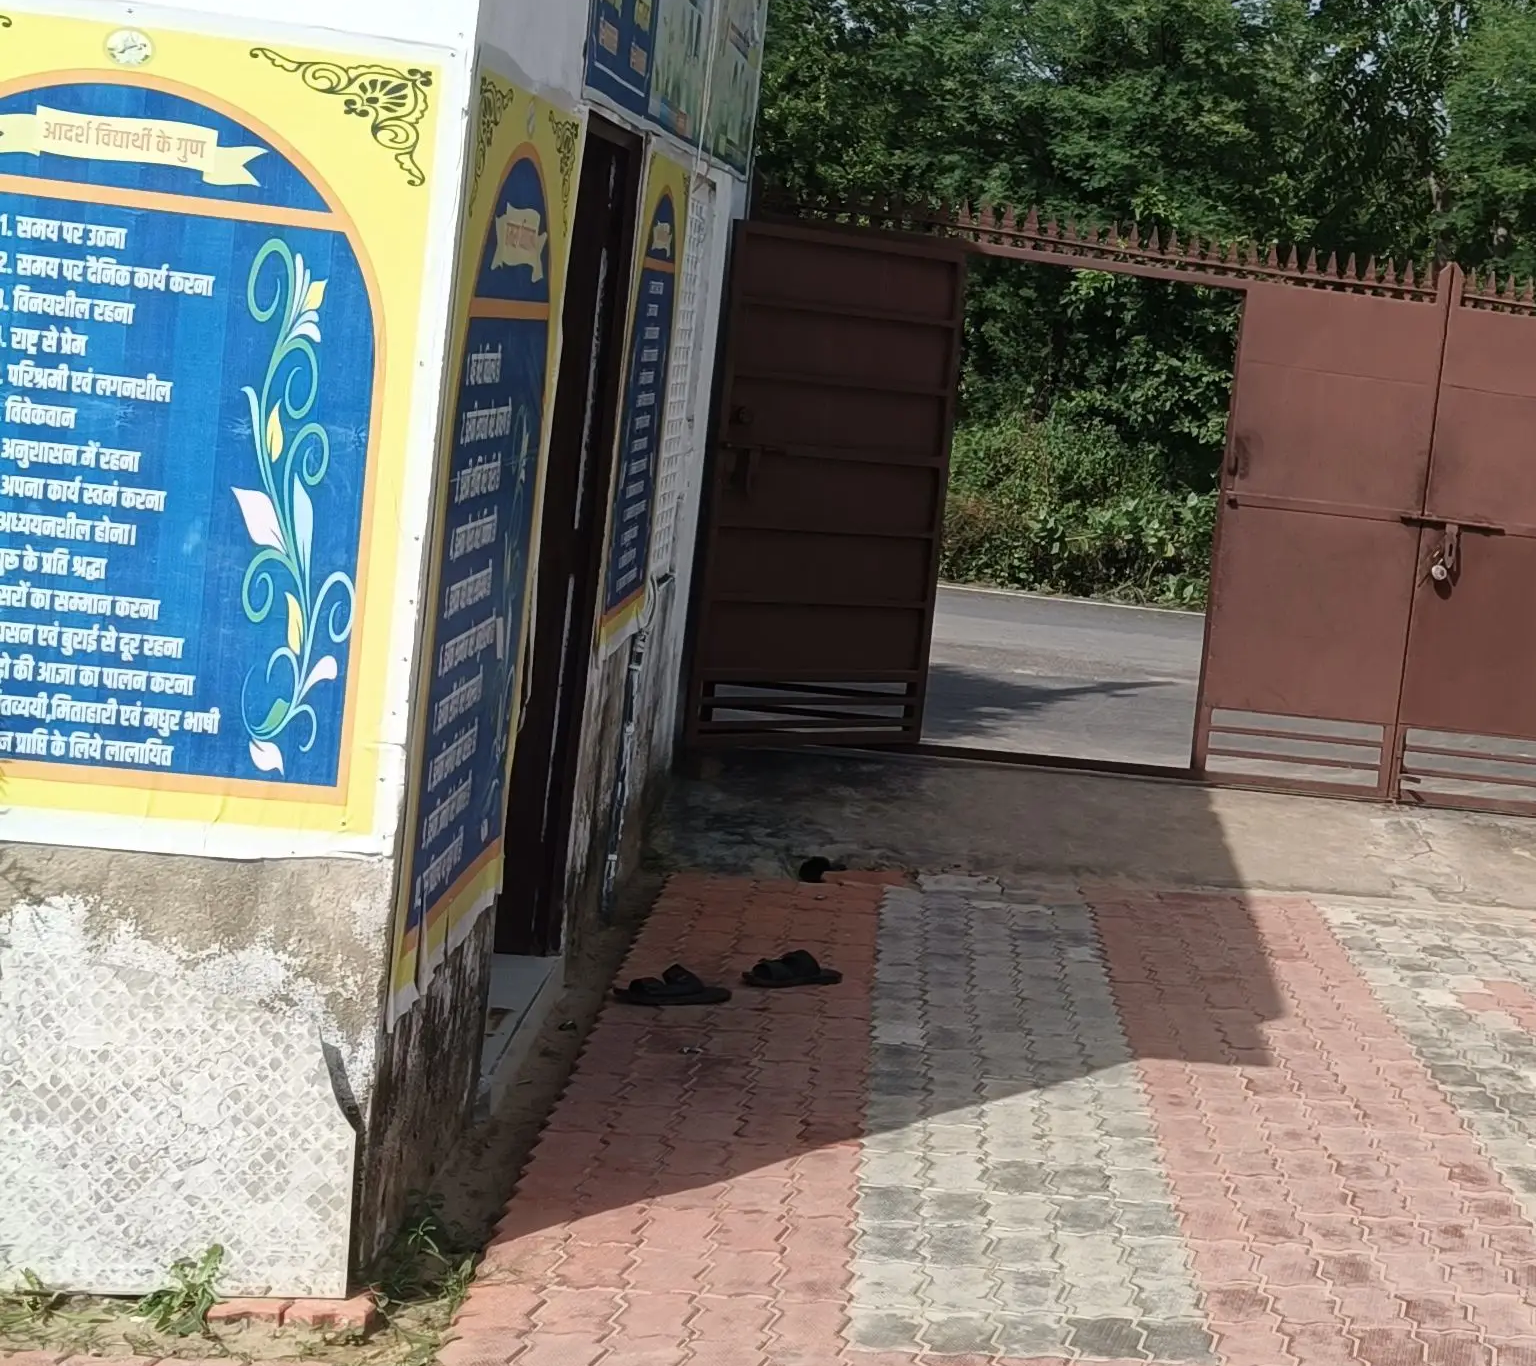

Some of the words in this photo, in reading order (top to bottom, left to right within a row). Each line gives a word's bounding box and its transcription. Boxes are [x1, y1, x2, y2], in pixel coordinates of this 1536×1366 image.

[43, 121, 93, 144] आदर्श
[95, 124, 151, 152] विद्यार्थी
[156, 131, 172, 153] के
[176, 137, 207, 163] गुण
[15, 215, 62, 242] समय
[61, 221, 86, 245] पर
[86, 224, 128, 250] उठना
[15, 253, 61, 279] समय
[61, 259, 86, 282] पर
[86, 255, 133, 286] दैनिक
[133, 264, 169, 289] कार्य
[169, 273, 215, 297] करना
[12, 284, 92, 320] विनयशील
[93, 300, 135, 325] रहना
[41, 325, 59, 353] से
[60, 326, 88, 356] प्रेम
[7, 359, 70, 391] परिश्रमी
[71, 367, 94, 394] एवं
[94, 373, 173, 403] लगनशील
[5, 395, 77, 429] विवेकवान
[1, 438, 79, 469] अनुशासन
[80, 439, 100, 467] में
[99, 448, 141, 473] रहना
[1, 475, 45, 500] अपना
[46, 475, 83, 502] कार्य
[120, 488, 167, 512] करना
[0, 511, 93, 541] अध्ययनशील
[22, 544, 41, 572] के
[41, 548, 70, 576] प्रति
[71, 555, 108, 581] श्रद्धा
[0, 580, 31, 608] सरों
[30, 587, 54, 610] का
[53, 589, 114, 616] सम्मान
[115, 597, 160, 621] करना
[37, 620, 60, 647] एवं
[61, 623, 100, 656] बुराई
[100, 626, 119, 650] से
[119, 635, 143, 662] दूर
[143, 637, 184, 658] रहना
[13, 653, 35, 681] की
[37, 661, 78, 686] आज्ञा
[79, 665, 102, 688] का
[102, 669, 150, 692] पालन
[150, 673, 196, 697] करना
[120, 704, 144, 727] एवं
[143, 709, 182, 737] मधुर
[182, 707, 221, 735] भाषी
[50, 729, 68, 756] के
[69, 731, 103, 760] लिये
[104, 739, 174, 767] लालायित
